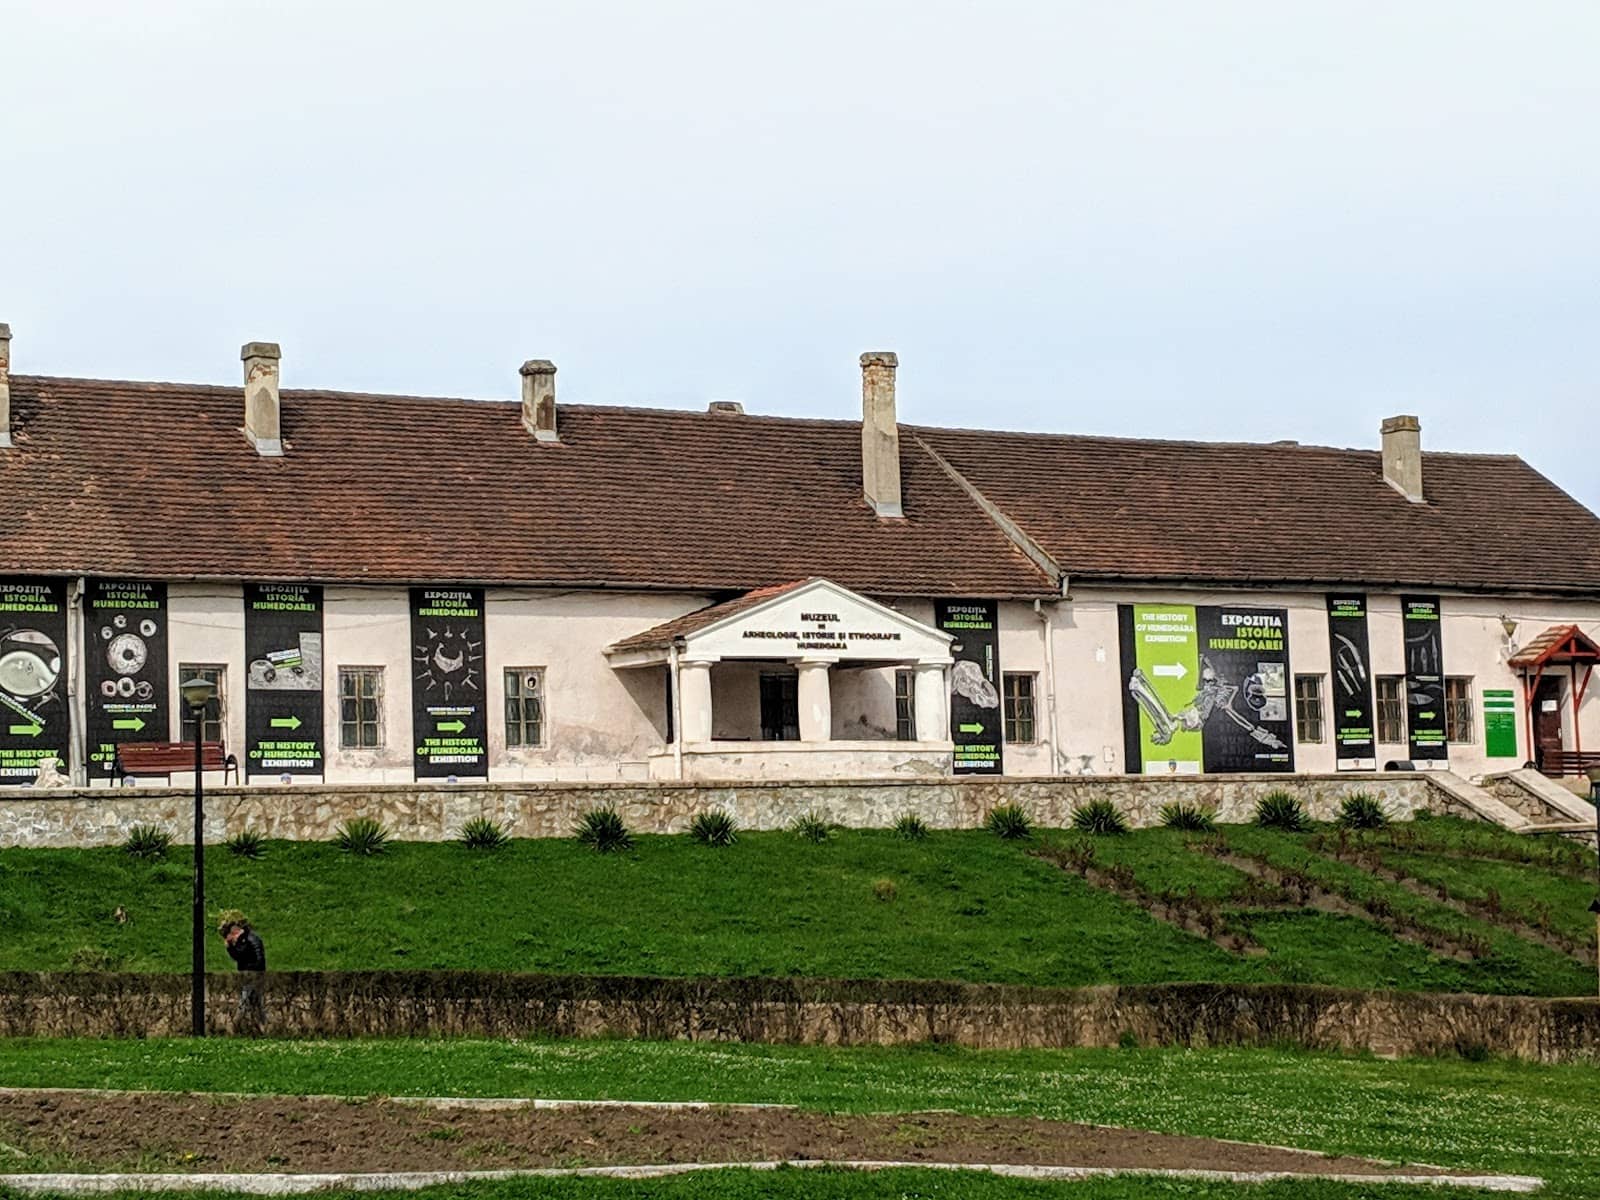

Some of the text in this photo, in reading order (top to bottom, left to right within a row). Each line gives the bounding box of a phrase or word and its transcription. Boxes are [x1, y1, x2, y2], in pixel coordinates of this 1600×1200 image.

[4, 594, 47, 602] ISTORIA
[106, 591, 148, 600] ISTORIA
[266, 593, 305, 602] ISTORIA
[92, 600, 160, 609] HUNEDOAREI
[252, 602, 316, 611] HUNEDOAREI
[431, 599, 469, 608] ISTORIA
[800, 613, 841, 622] MUZEUL
[802, 632, 835, 640] ISTORIE
[848, 632, 901, 640] ETNOGRAFIE
[1236, 627, 1282, 639] ISTORIA
[1208, 639, 1284, 651] HUNEDOAREI
[276, 742, 316, 750] HISTORY
[15, 750, 59, 758] HISTORY
[249, 751, 321, 759] OF HUNEDOARA
[416, 747, 429, 755] OF
